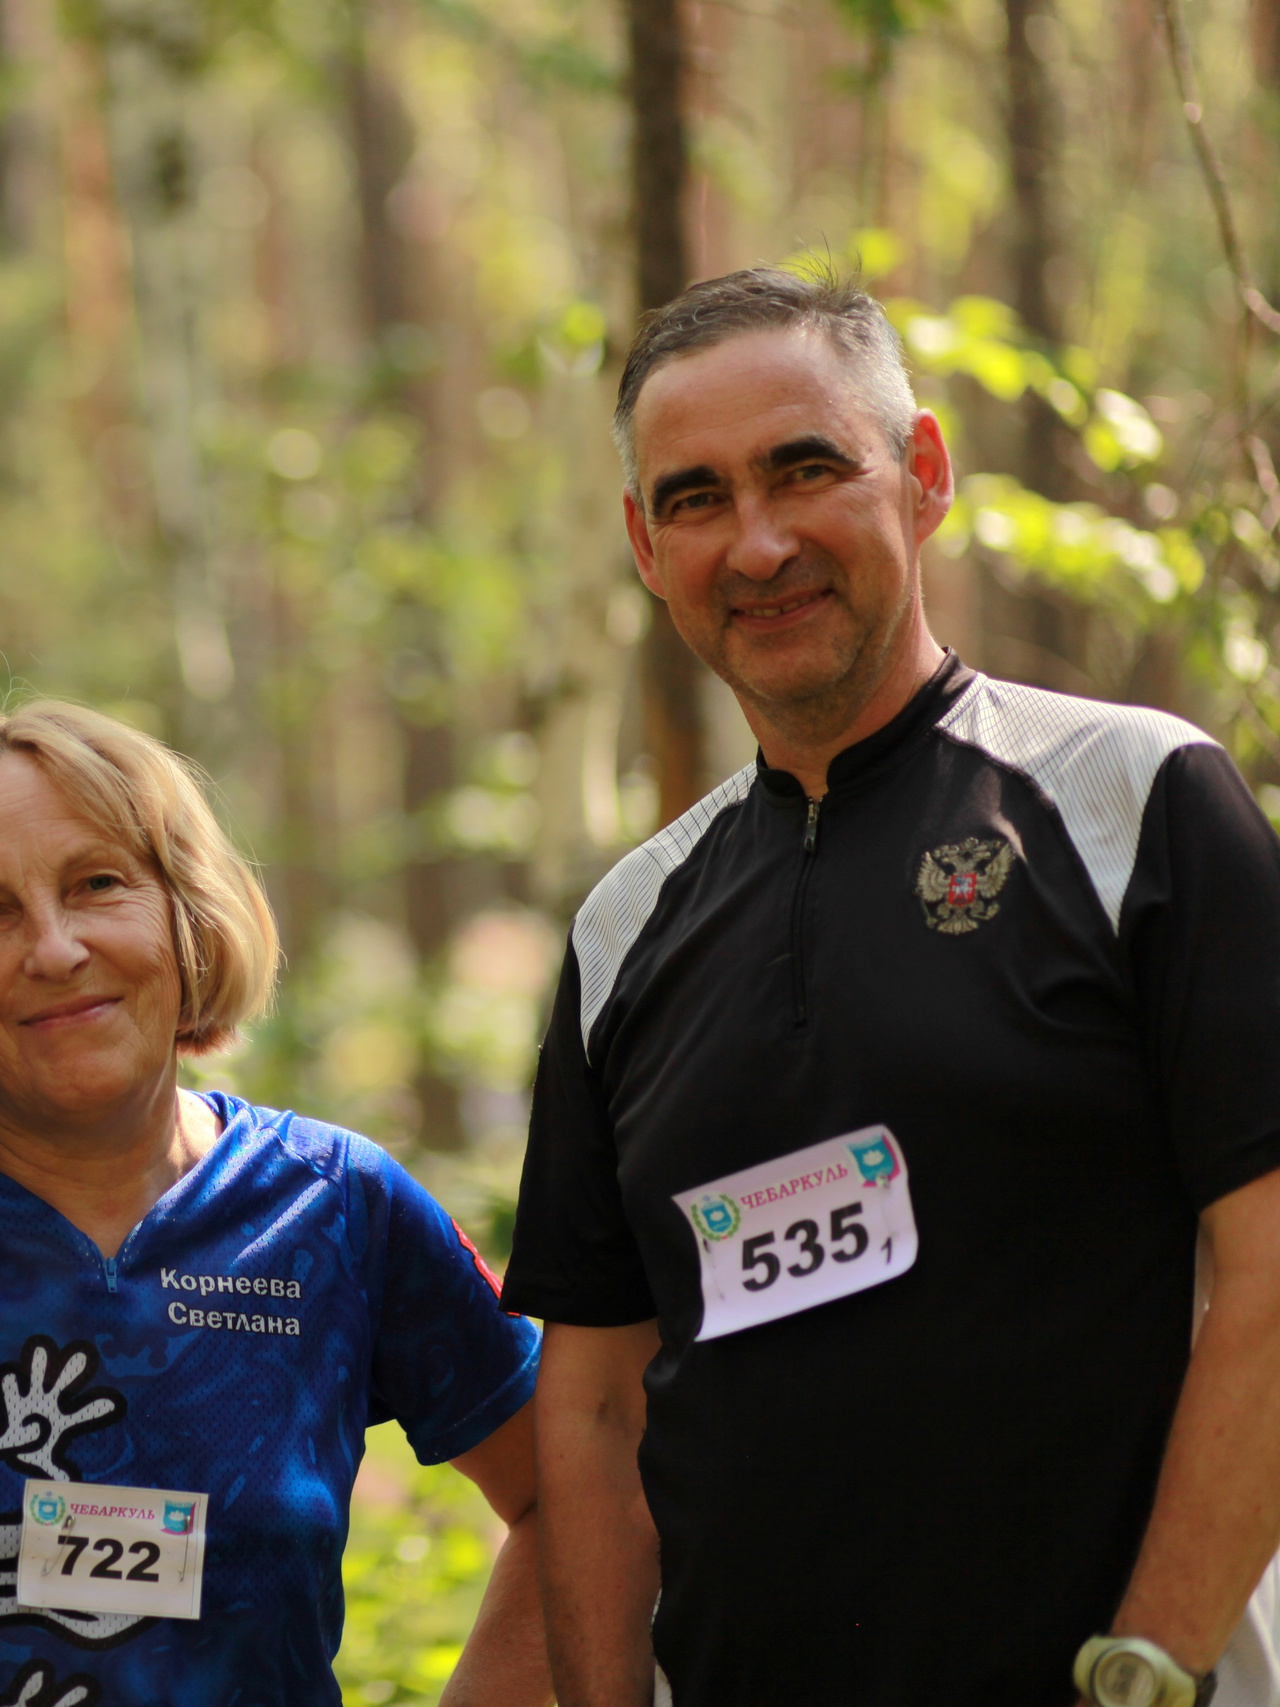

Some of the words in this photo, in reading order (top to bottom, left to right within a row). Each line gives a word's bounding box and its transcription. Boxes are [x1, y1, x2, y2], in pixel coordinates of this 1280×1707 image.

[740, 1163, 849, 1210] ЧЕБАРКУЛЬ
[742, 1201, 869, 1293] 535
[160, 1267, 301, 1299] Корнеева
[167, 1301, 301, 1336] Светлана
[70, 1503, 156, 1521] ЧЕБАРКУЛЬ
[57, 1534, 161, 1583] 722
